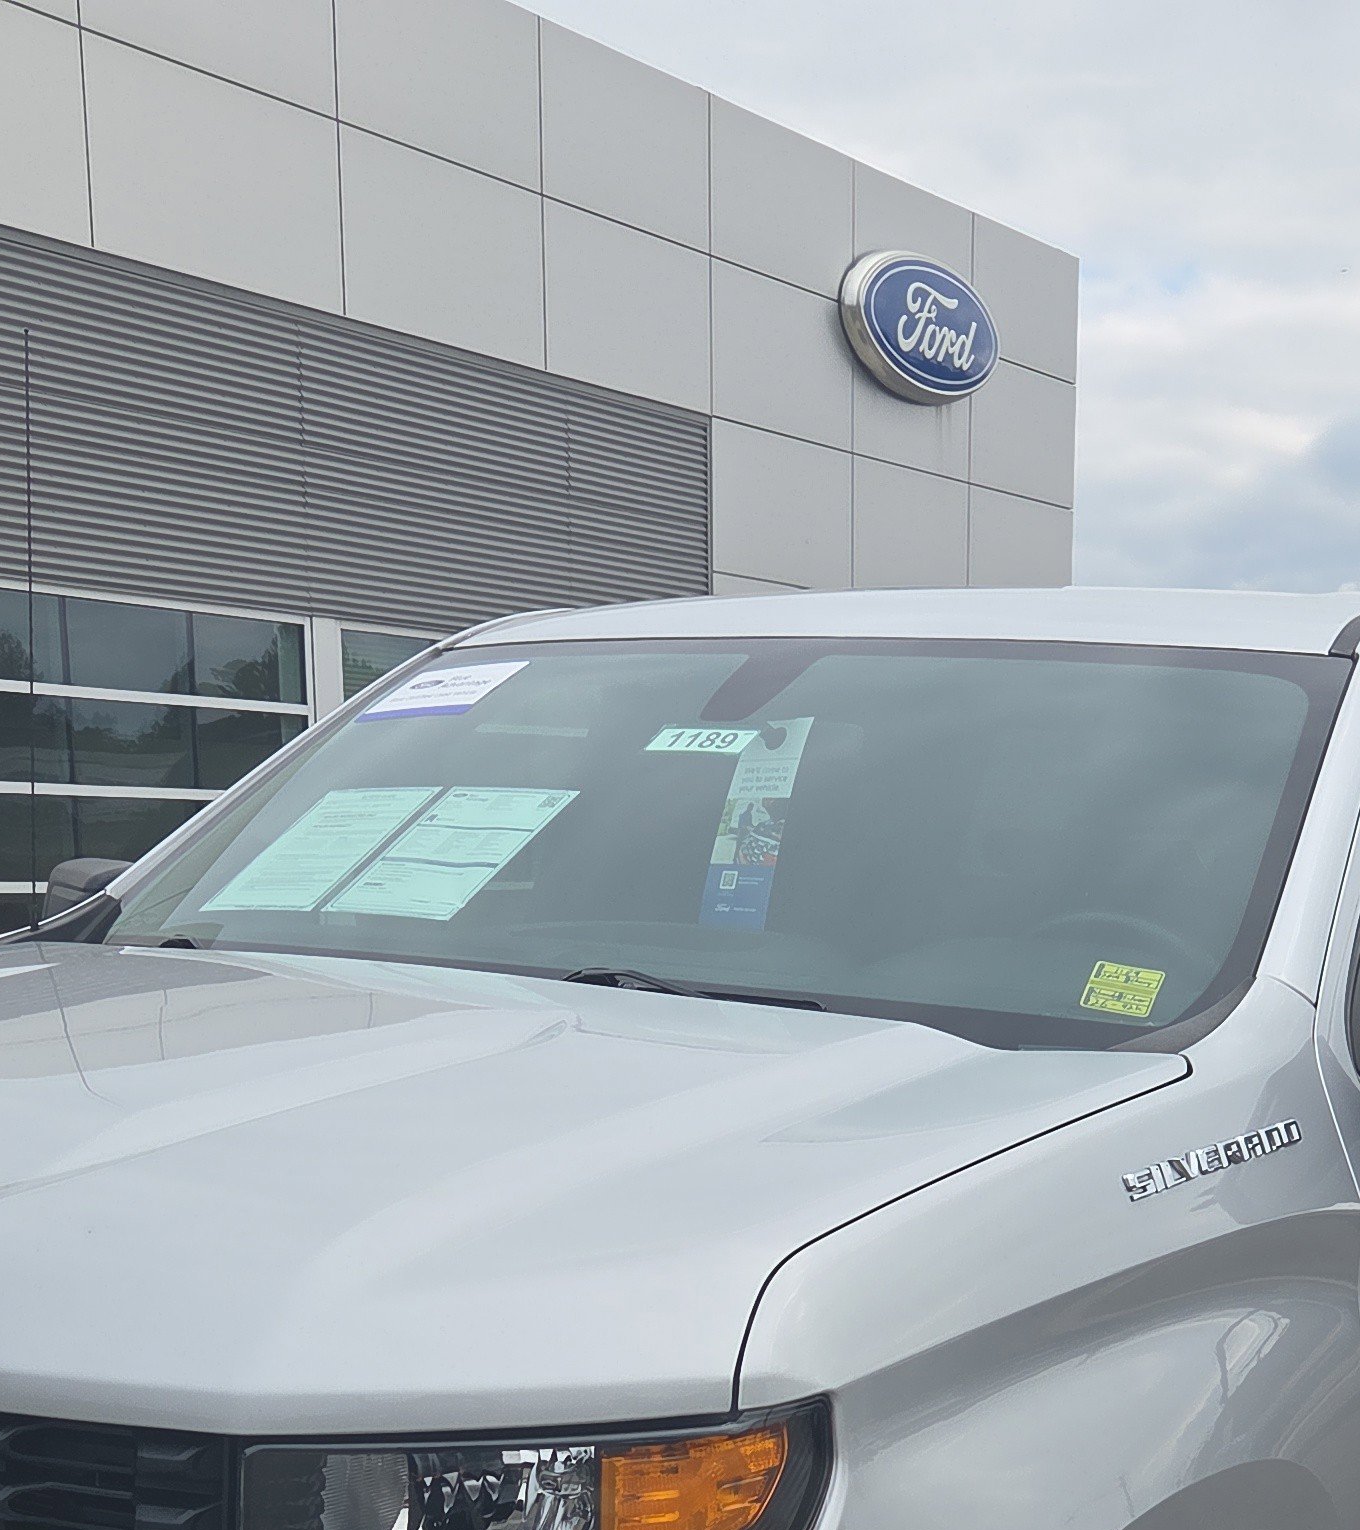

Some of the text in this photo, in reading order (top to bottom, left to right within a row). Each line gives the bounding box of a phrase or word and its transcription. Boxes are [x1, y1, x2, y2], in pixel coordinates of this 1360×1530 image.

[897, 282, 977, 371] Ford
[667, 731, 739, 750] 1189
[1122, 1119, 1303, 1202] SILVERADO
